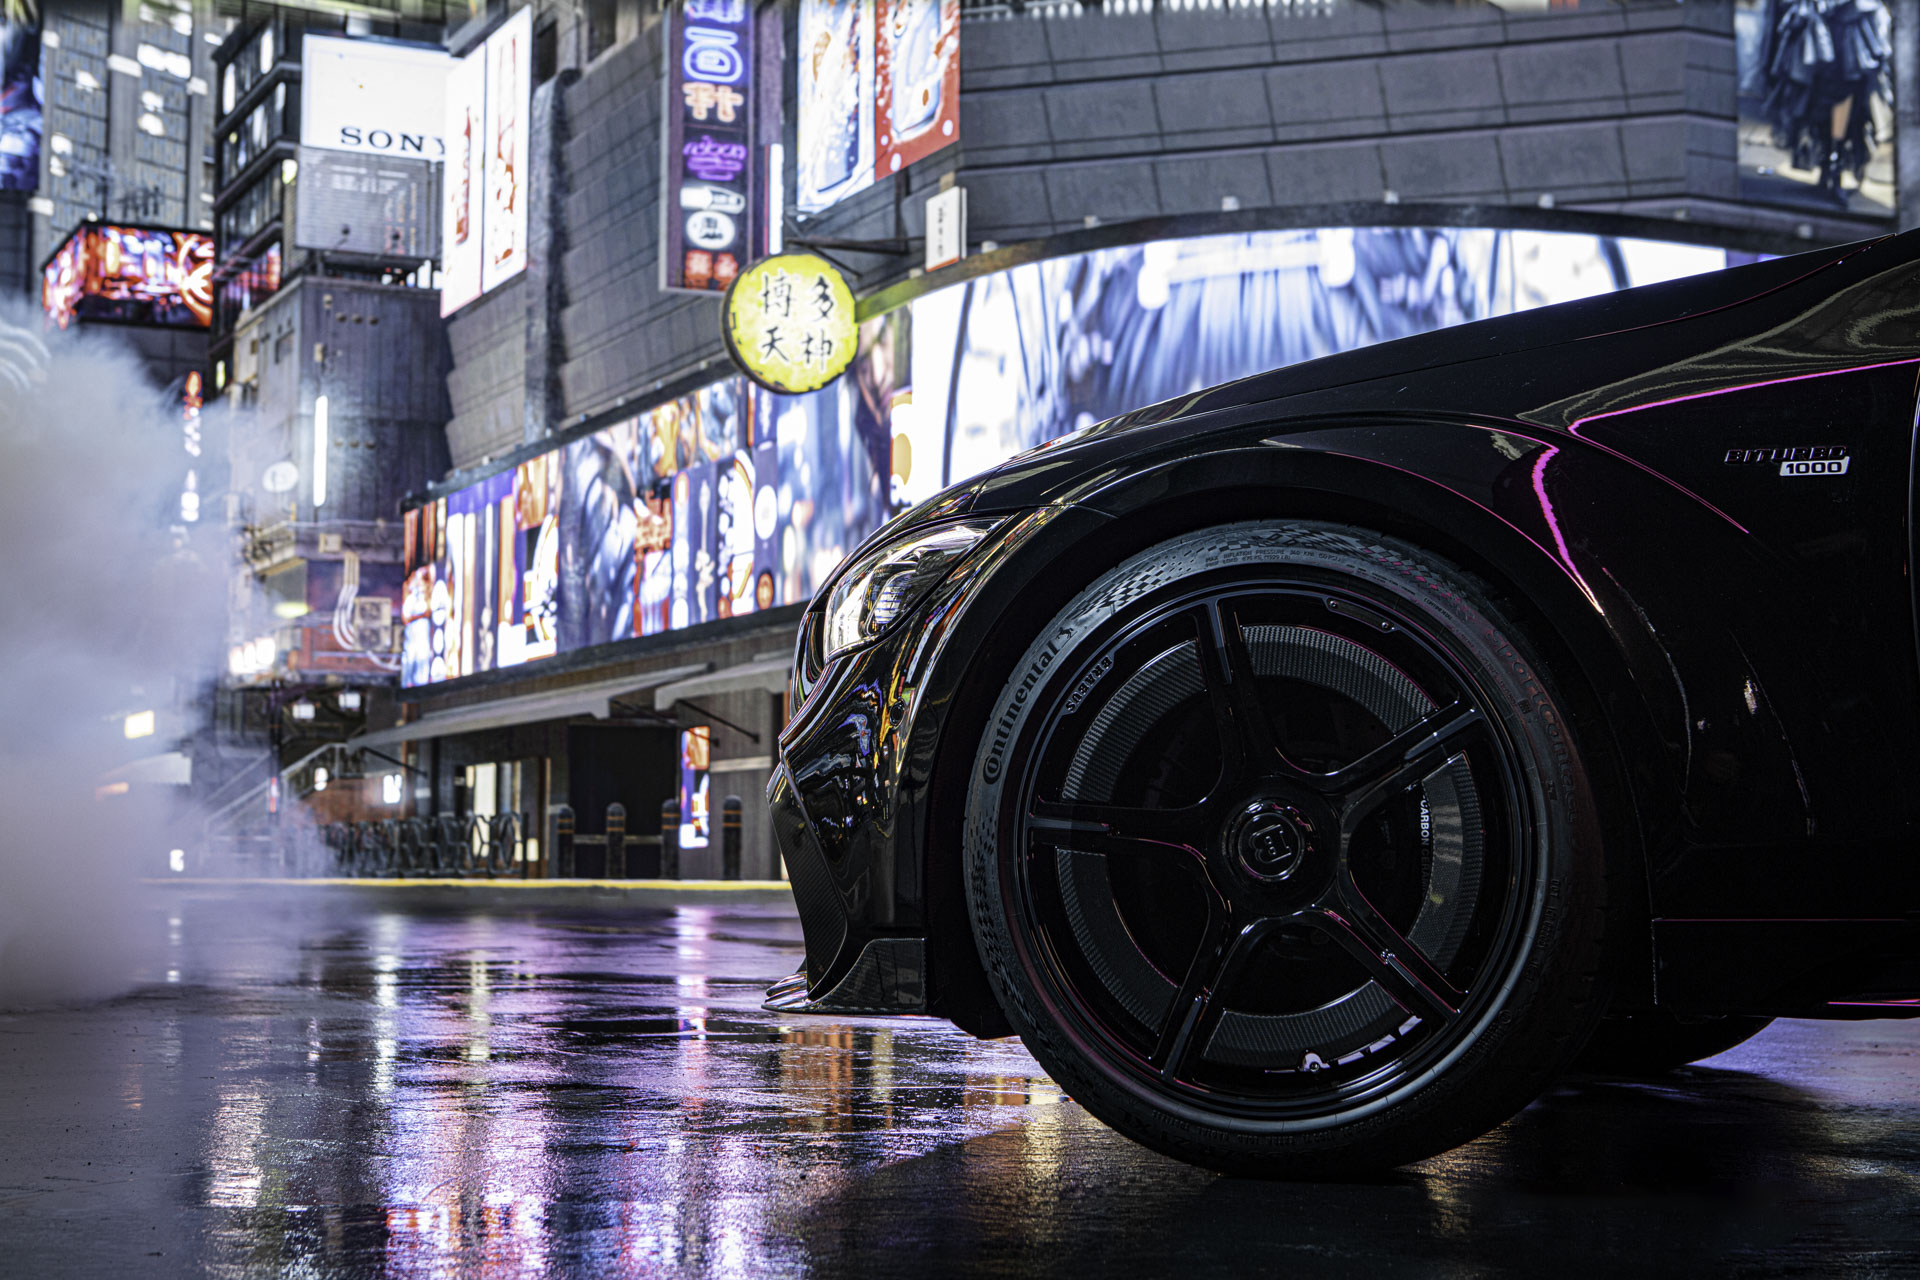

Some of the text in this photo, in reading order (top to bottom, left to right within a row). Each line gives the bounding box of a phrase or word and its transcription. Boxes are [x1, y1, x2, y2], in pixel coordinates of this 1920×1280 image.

[761, 326, 833, 371] 天神
[1724, 445, 1847, 465] BITURBO
[1786, 462, 1843, 475] 1000
[1065, 656, 1112, 712] BRABUS
[983, 641, 1060, 785] Continental
[1419, 799, 1430, 845] CARBON
